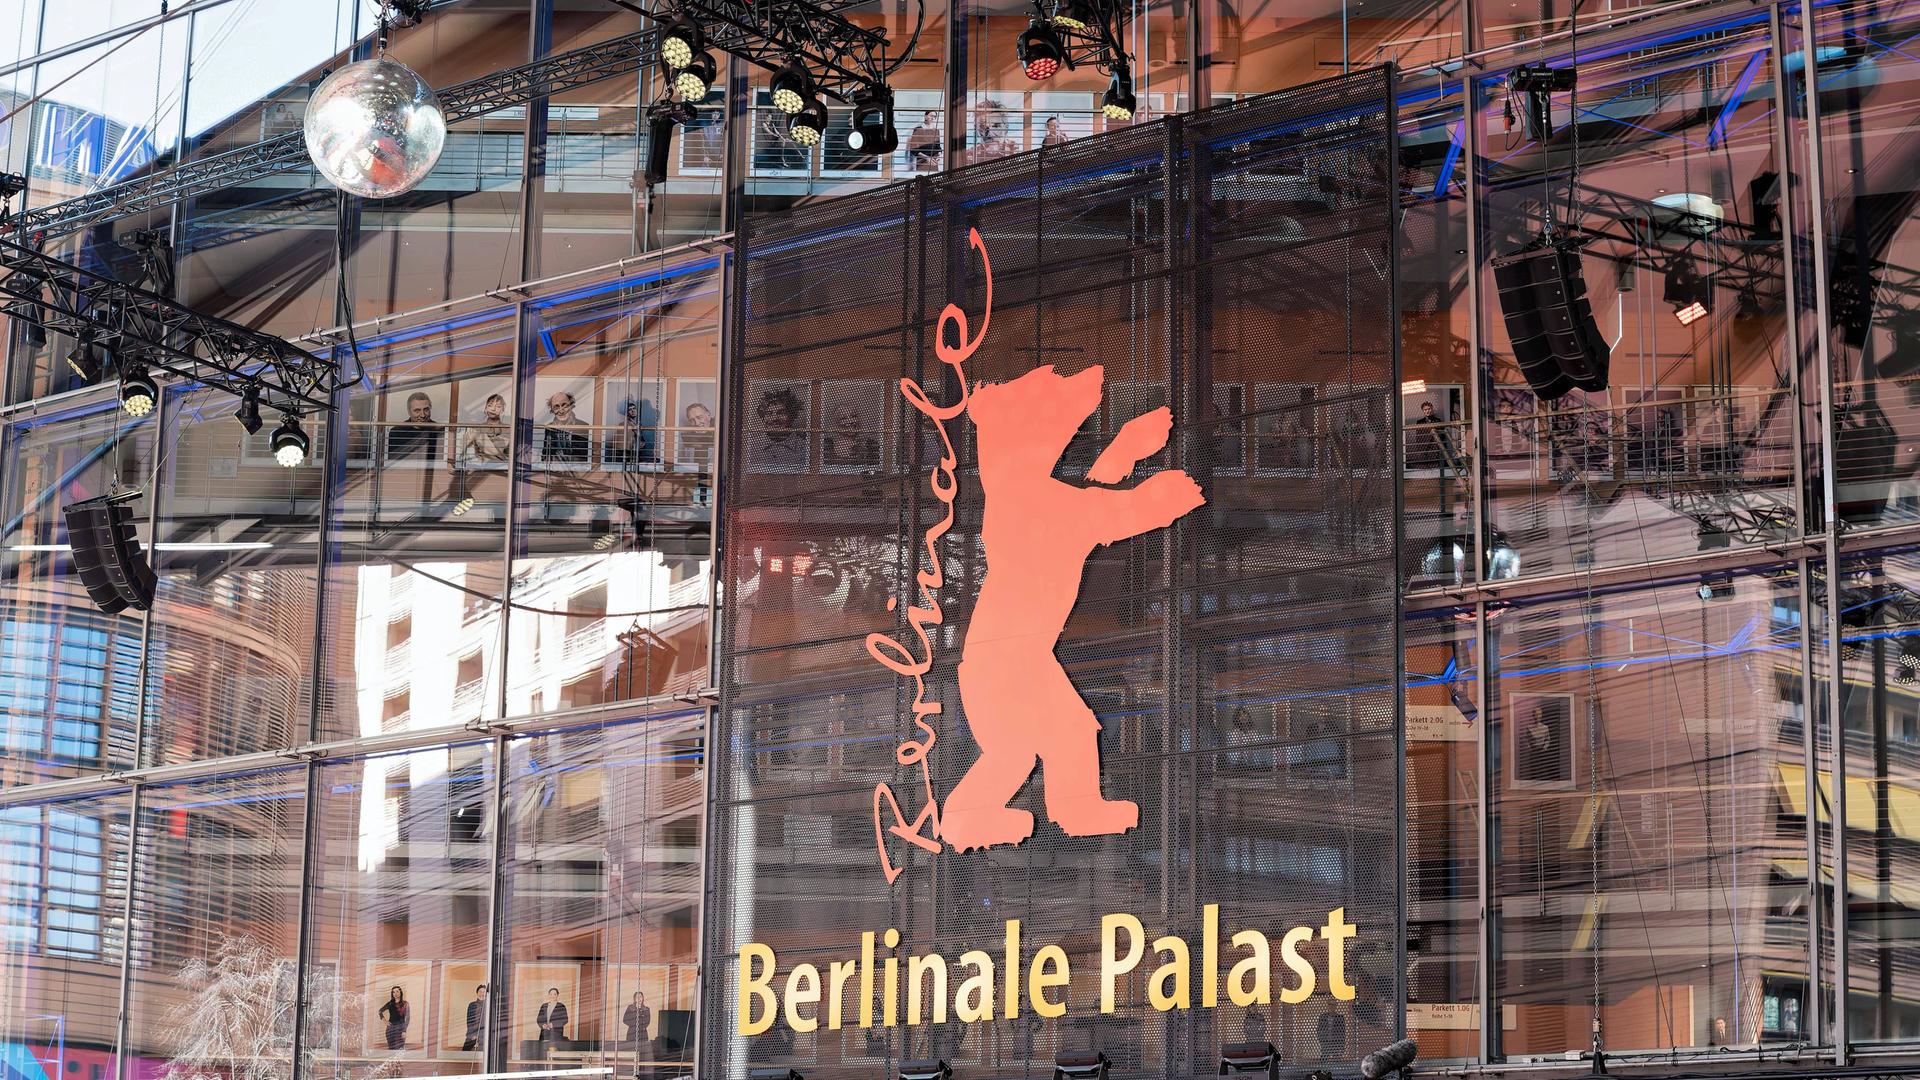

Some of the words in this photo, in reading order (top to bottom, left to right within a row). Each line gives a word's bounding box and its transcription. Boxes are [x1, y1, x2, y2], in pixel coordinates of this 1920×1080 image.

[866, 227, 992, 885] Berlinale
[738, 919, 1069, 1036] Berlinale
[1100, 904, 1357, 1014] Palast
